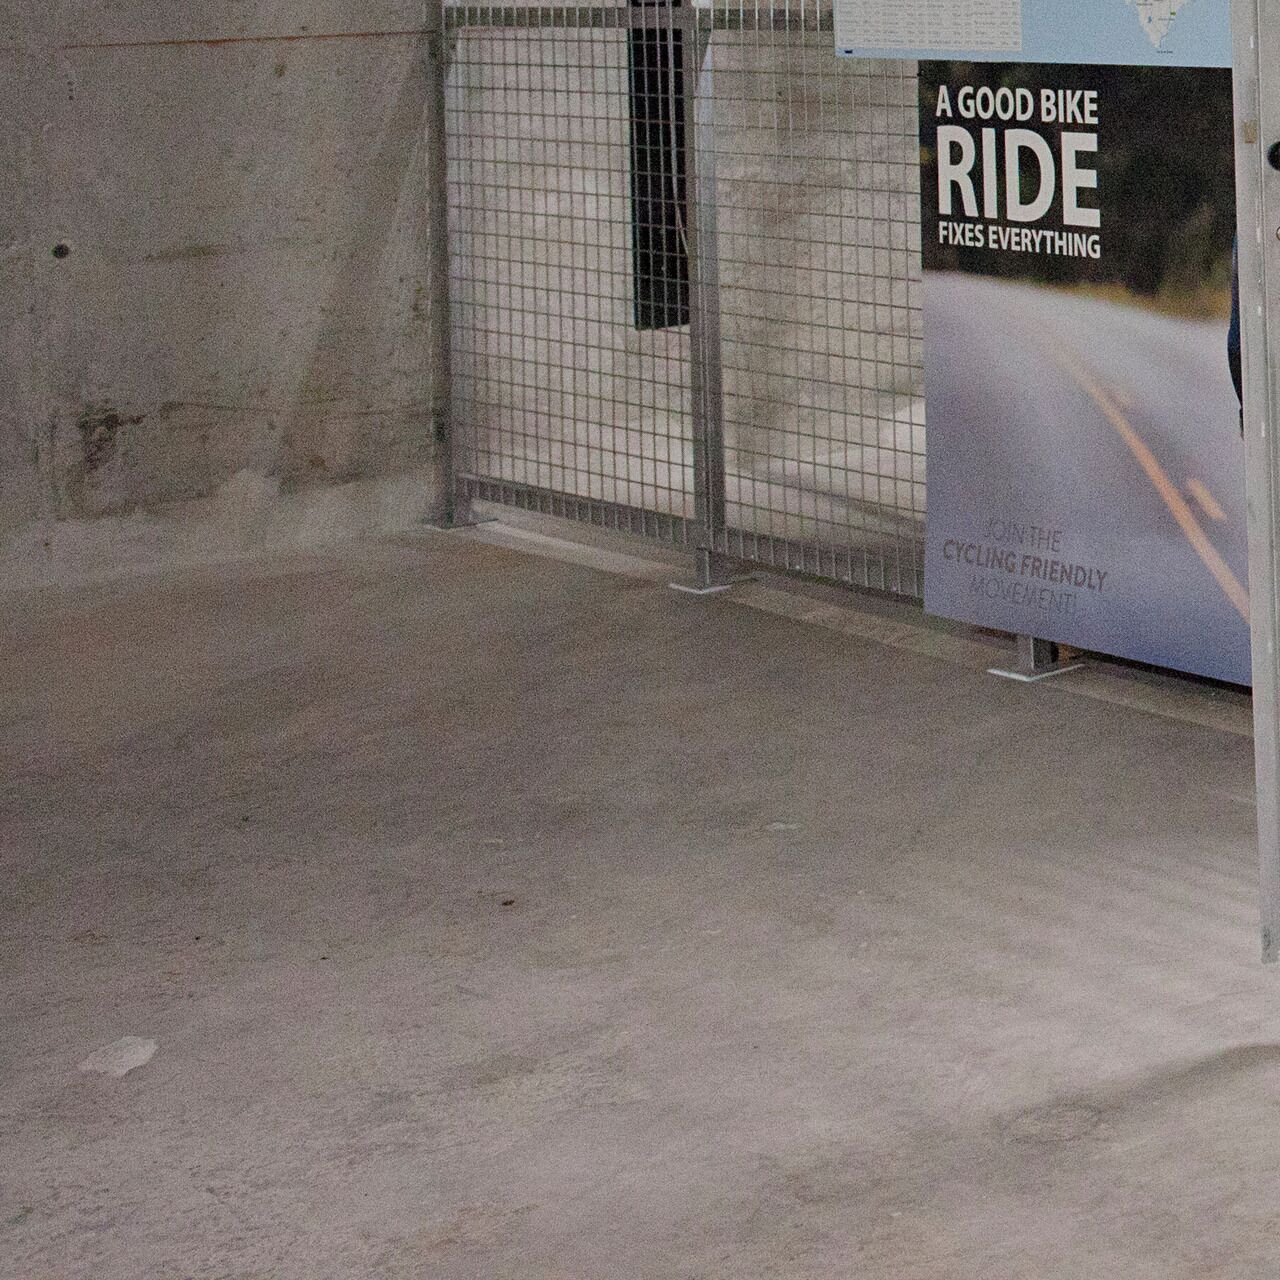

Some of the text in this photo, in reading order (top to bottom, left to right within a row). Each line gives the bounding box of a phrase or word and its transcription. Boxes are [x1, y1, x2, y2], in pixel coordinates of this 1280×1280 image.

[936, 84, 1099, 124] A GOOD BIKE
[937, 124, 1101, 227] RIDE
[938, 220, 1101, 259] FIXES EVERYTHING
[983, 517, 1063, 553] JOIN THE
[943, 538, 1108, 592] CYCLING FRIENDLY
[971, 575, 1077, 614] MOVEMENT!
